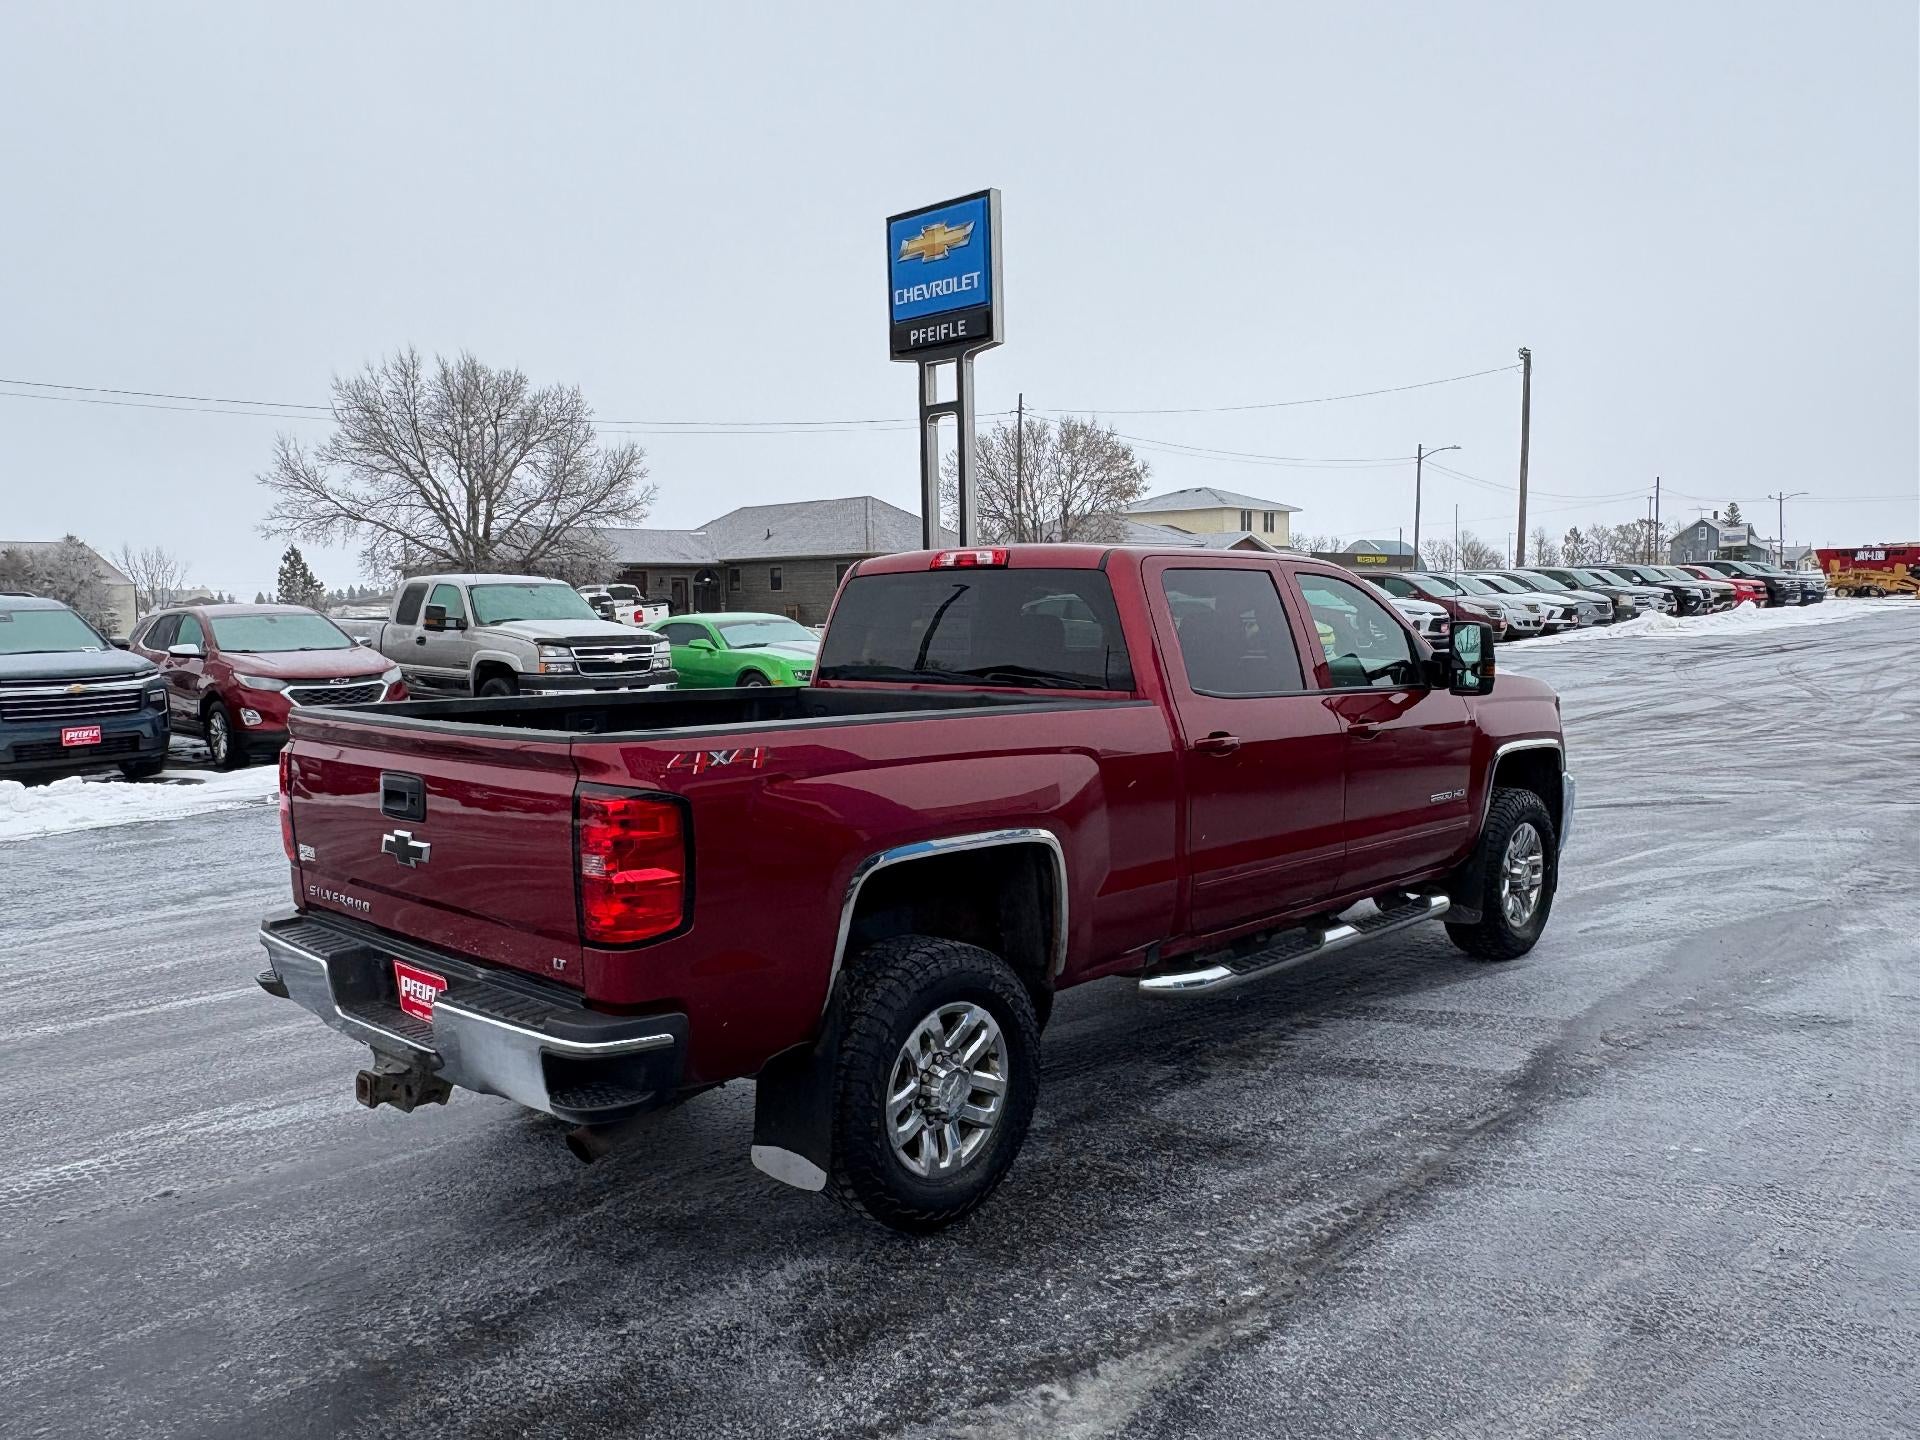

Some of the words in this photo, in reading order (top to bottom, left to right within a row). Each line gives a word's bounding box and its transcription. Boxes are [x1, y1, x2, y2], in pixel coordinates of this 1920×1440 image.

[894, 271, 981, 305] CHEVROLET
[910, 319, 968, 346] PFEIFLE
[309, 884, 370, 913] SILVERADO
[553, 957, 567, 970] LT
